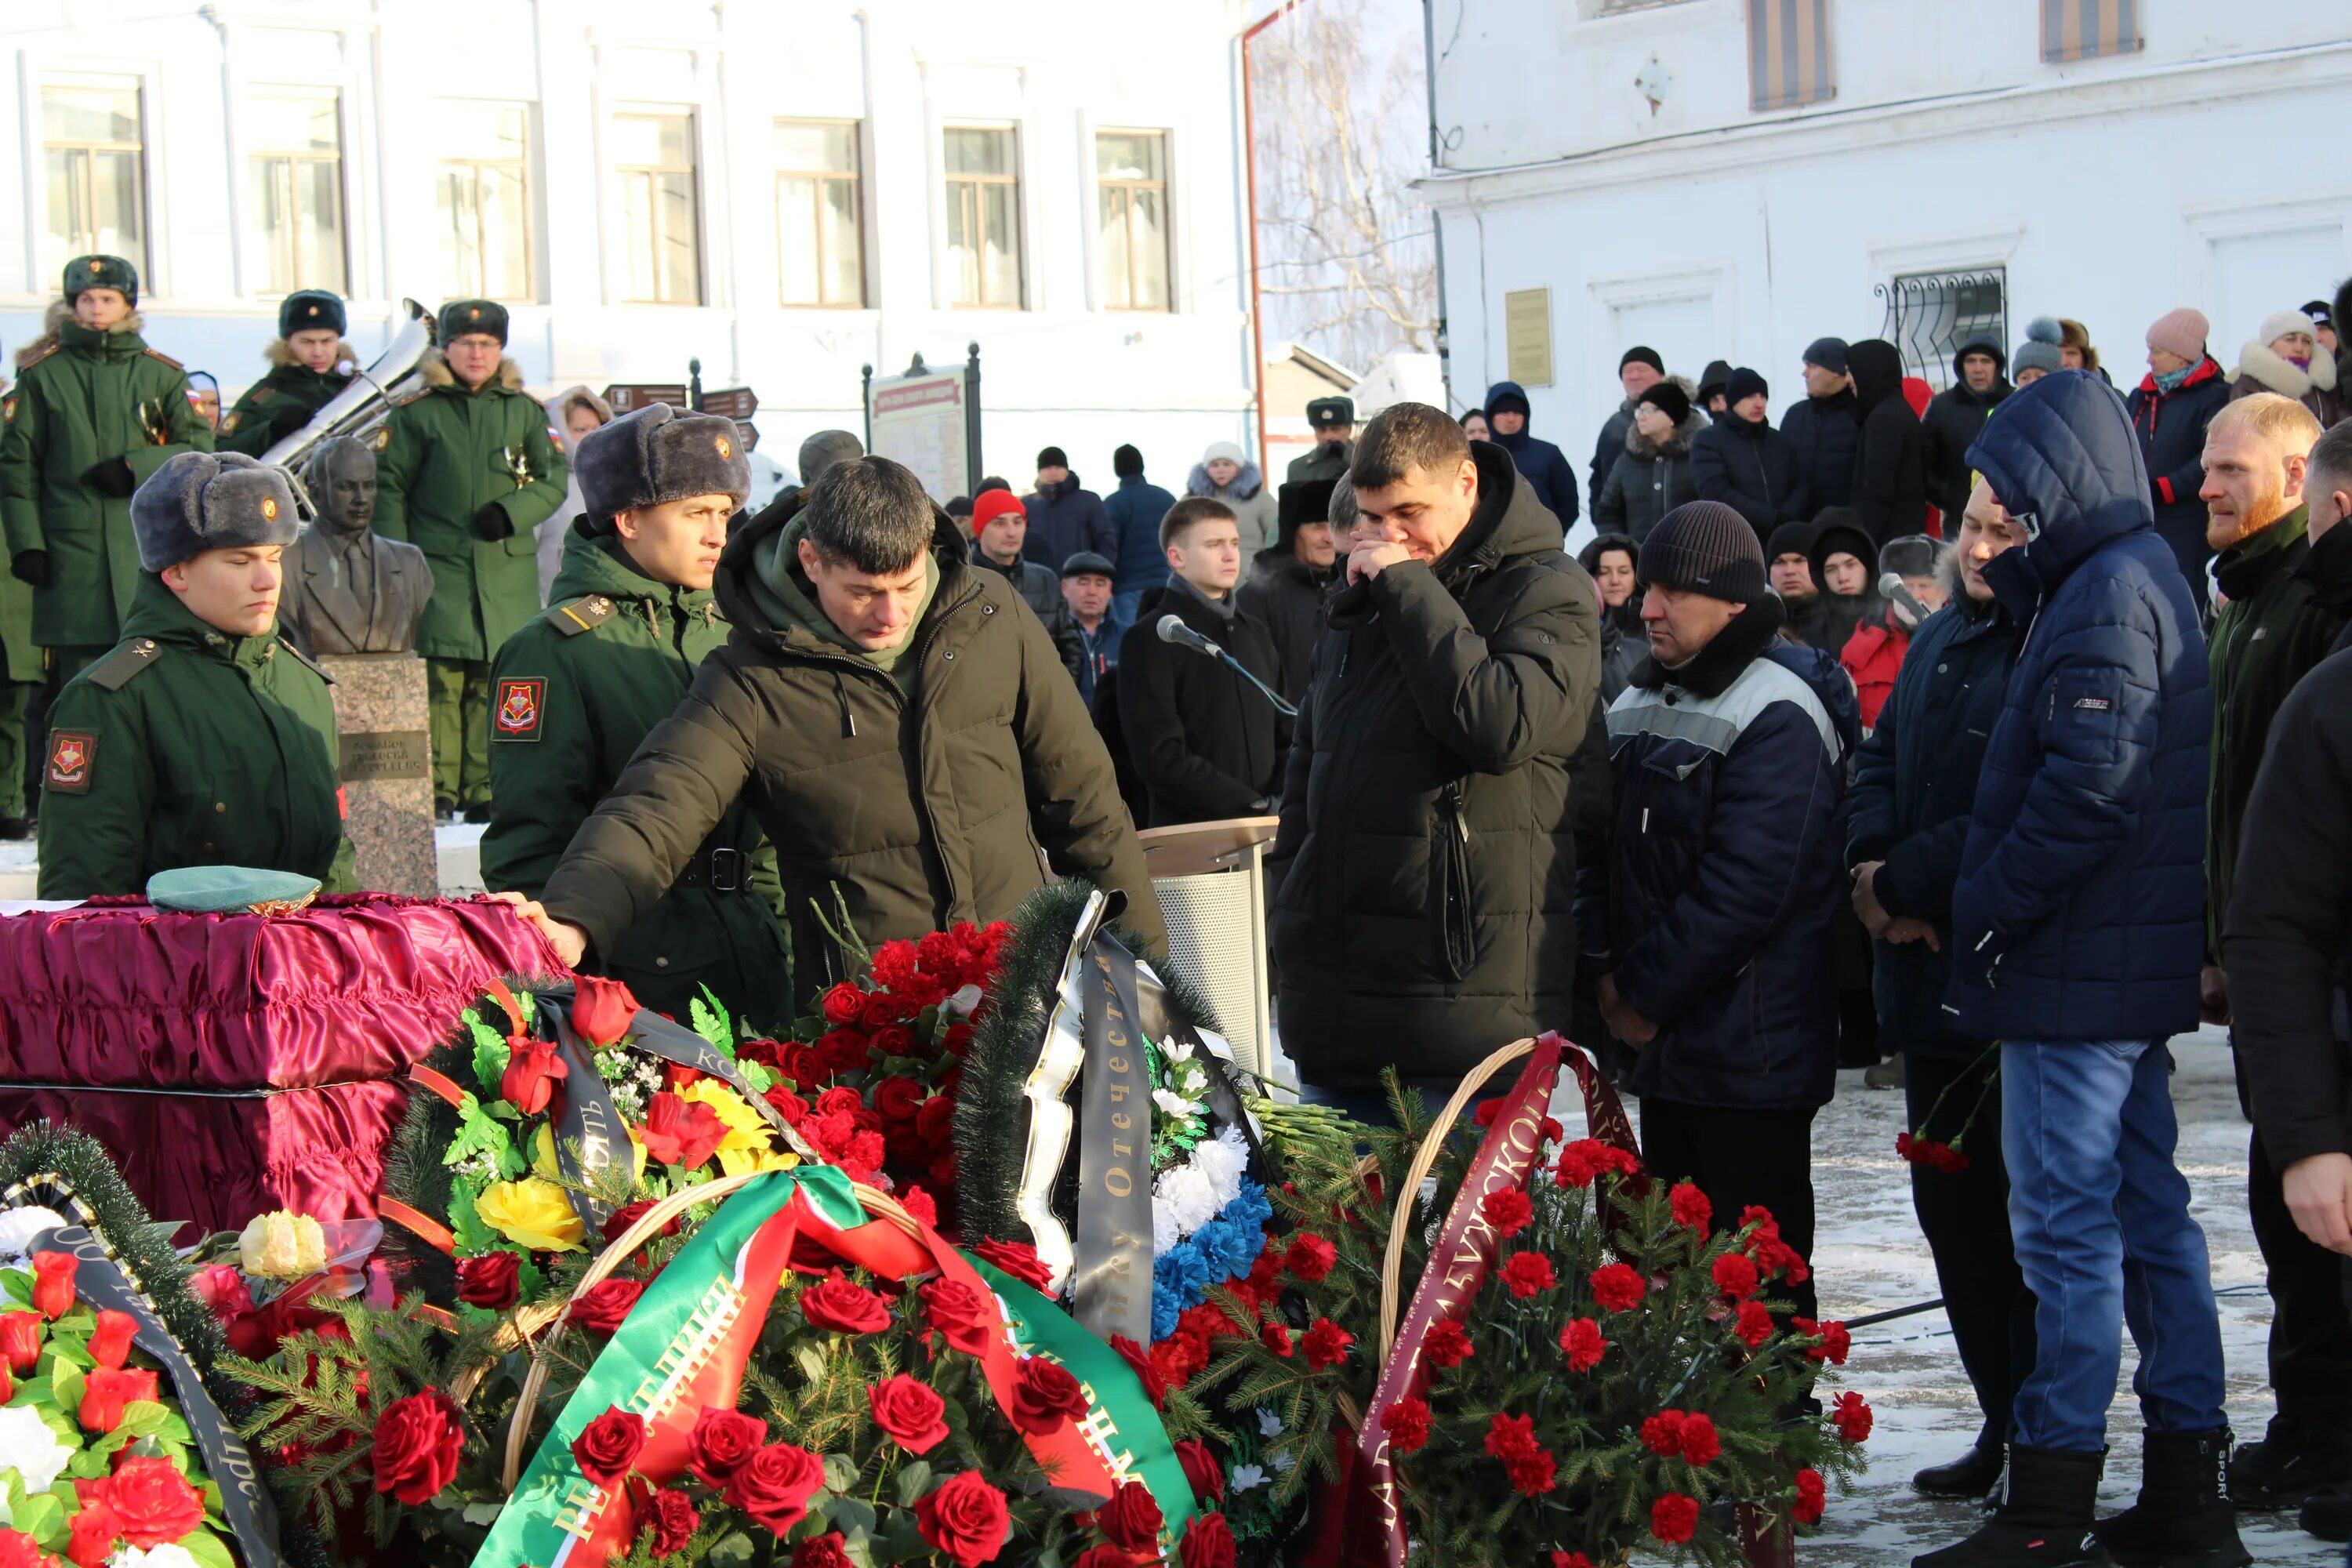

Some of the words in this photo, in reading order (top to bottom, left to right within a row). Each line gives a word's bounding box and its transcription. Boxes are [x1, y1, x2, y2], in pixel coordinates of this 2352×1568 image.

[1094, 954, 1131, 1199] Отечества
[551, 1272, 747, 1544] РЕУБЛИКИ
[2217, 1450, 2230, 1501] SPORT
